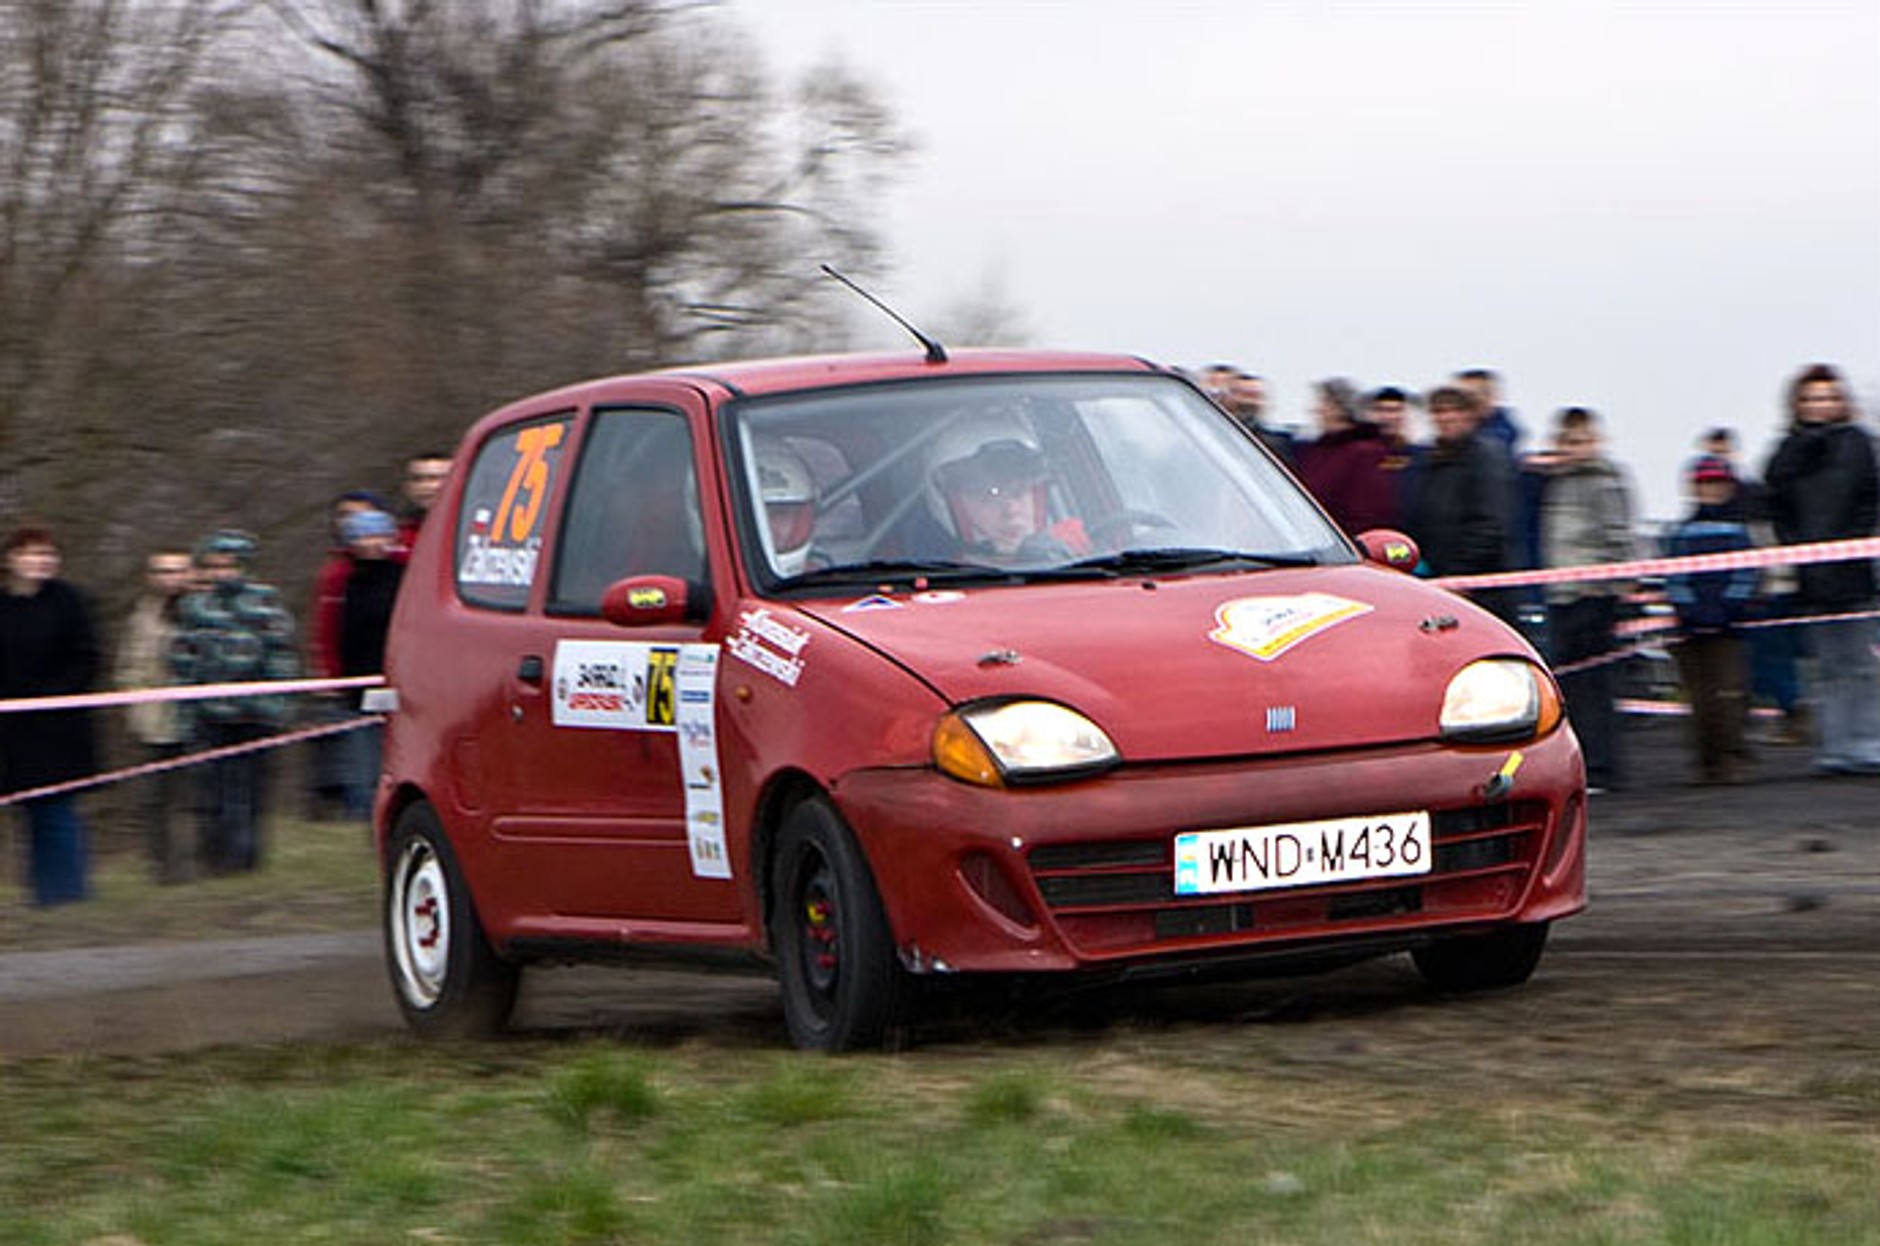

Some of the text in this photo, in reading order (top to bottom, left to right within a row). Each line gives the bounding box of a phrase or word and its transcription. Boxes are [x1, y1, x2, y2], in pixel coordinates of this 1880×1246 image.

[490, 423, 565, 542] 75
[647, 651, 677, 725] 75
[1208, 820, 1422, 884] WND M436
